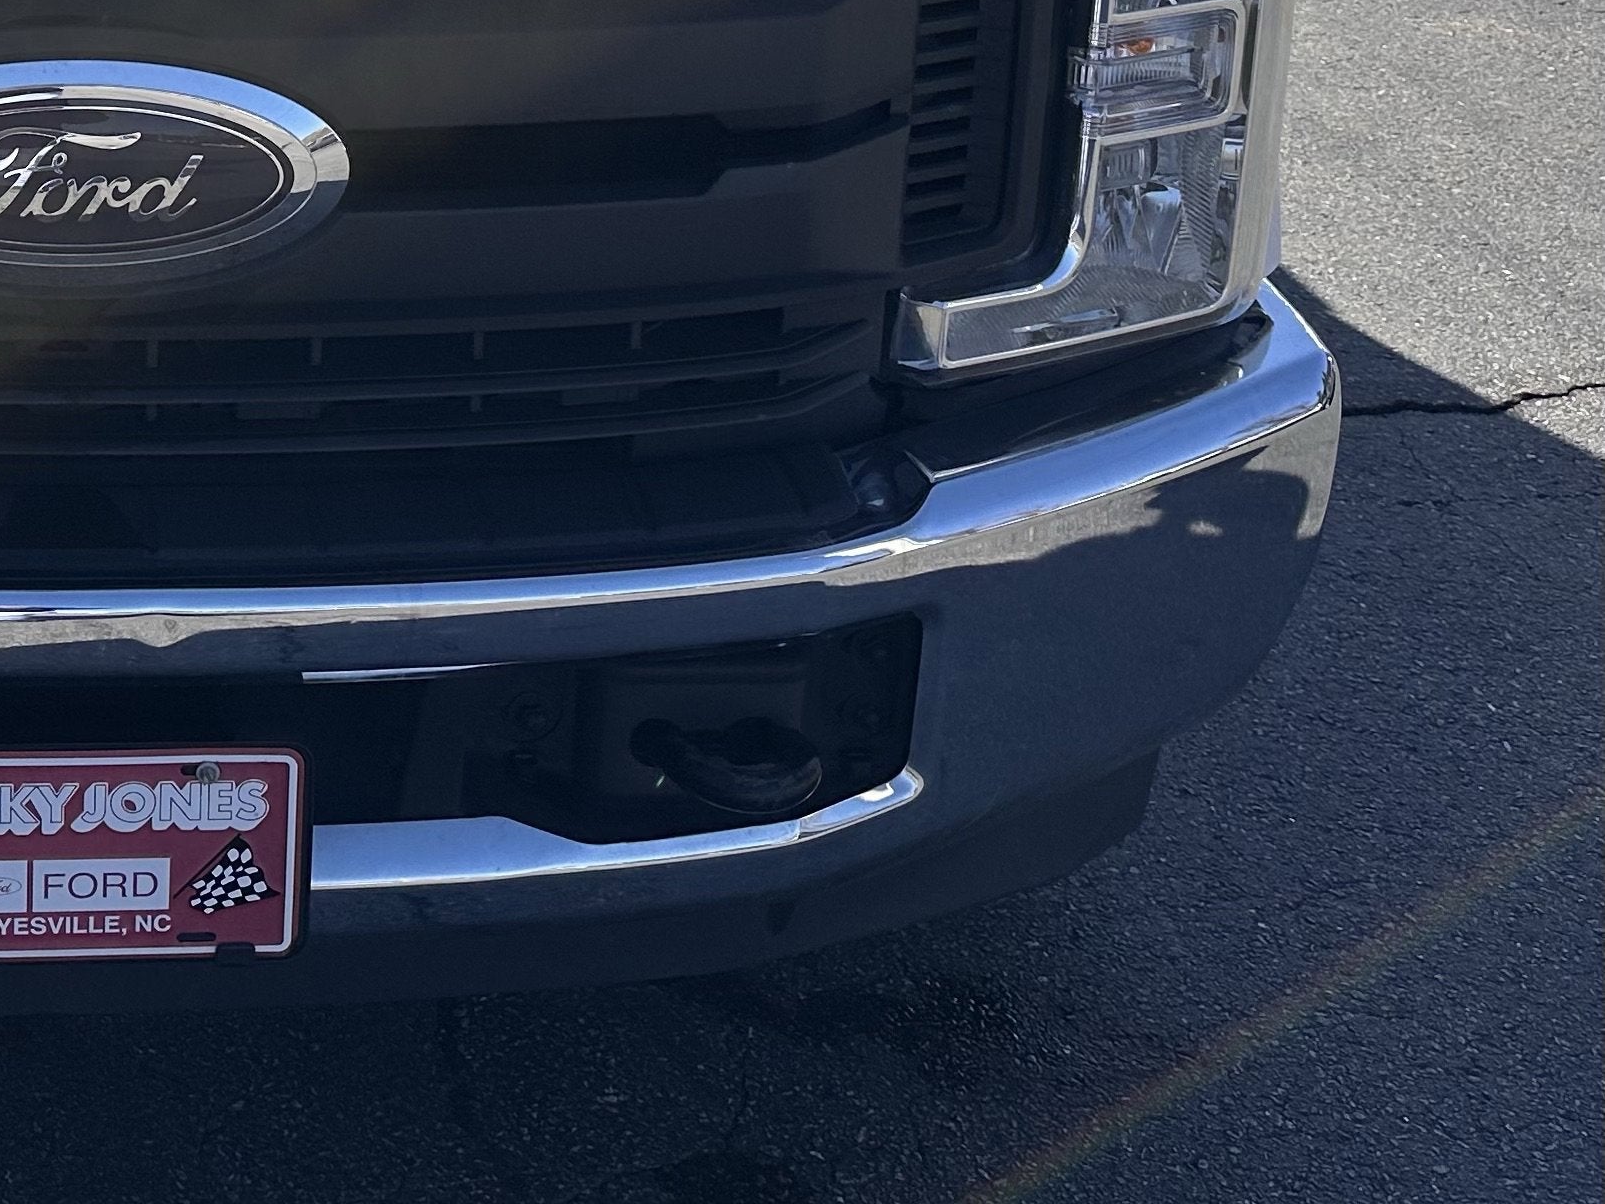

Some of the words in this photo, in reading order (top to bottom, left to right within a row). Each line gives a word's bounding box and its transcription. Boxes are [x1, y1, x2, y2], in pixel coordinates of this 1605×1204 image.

[70, 779, 270, 833] JONES
[43, 871, 159, 900] FORD
[134, 914, 172, 933] NC
